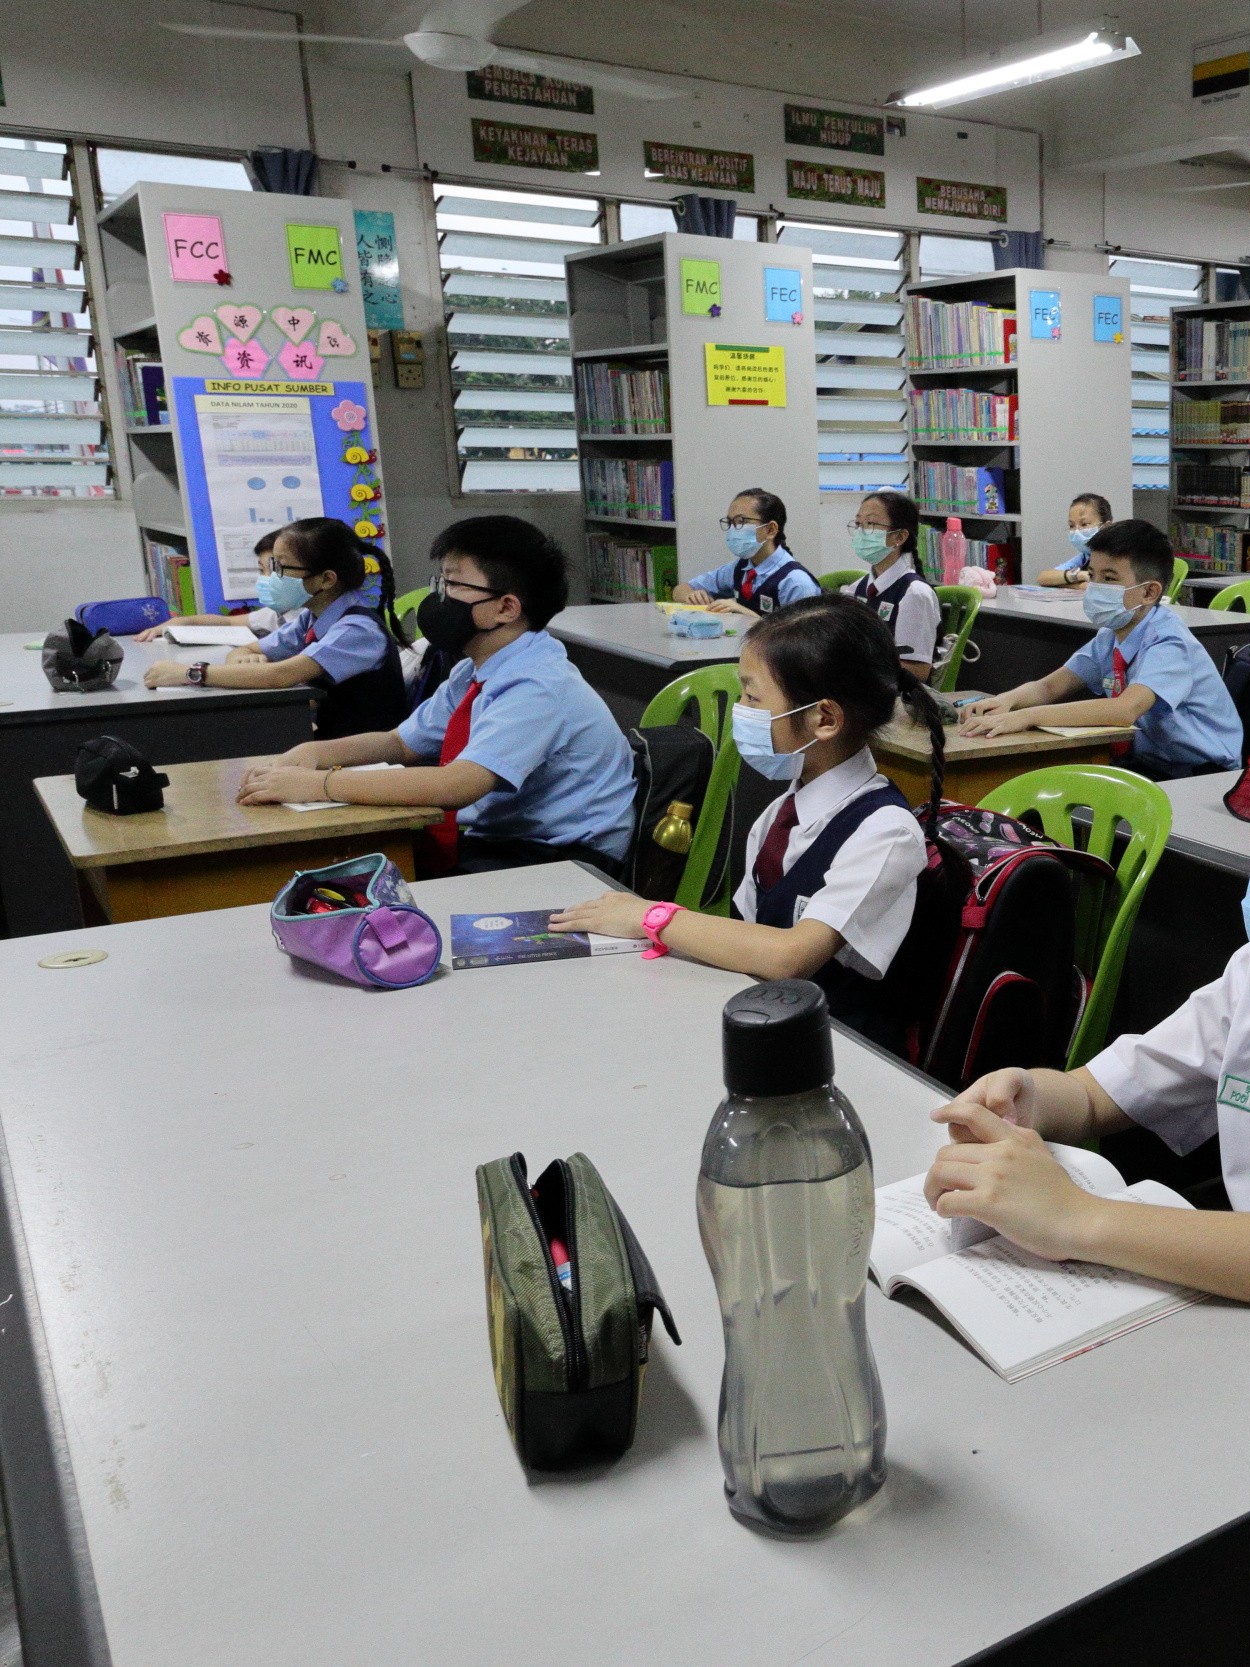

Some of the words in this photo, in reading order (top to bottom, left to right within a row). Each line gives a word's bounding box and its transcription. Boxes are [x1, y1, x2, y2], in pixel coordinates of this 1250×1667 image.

[484, 80, 577, 107] PENGETAHUAN
[479, 125, 548, 146] KEYAKINAN
[555, 135, 593, 153] TERAS
[507, 146, 568, 166] KEJAYAAN
[651, 147, 707, 166] BERFIKIRAN
[713, 155, 748, 172] POSITIF
[664, 164, 689, 180] ASAS
[691, 168, 738, 186] KEJAYAAN
[792, 169, 818, 191] MAJU
[822, 173, 853, 195] TERUS
[856, 177, 881, 199] MAJU
[940, 185, 986, 202] BERUSAHA
[924, 196, 978, 215] MEMAJUKAN
[983, 203, 1001, 218] DIRI
[173, 238, 221, 260] FCC
[293, 247, 338, 266] FMC
[685, 278, 719, 295] FMC
[770, 287, 798, 303] FEC
[1033, 307, 1057, 321] FEC
[1097, 312, 1119, 325] FEC
[211, 382, 241, 392] INFO
[244, 383, 281, 393] PUSAT
[285, 384, 329, 394] SUMBER
